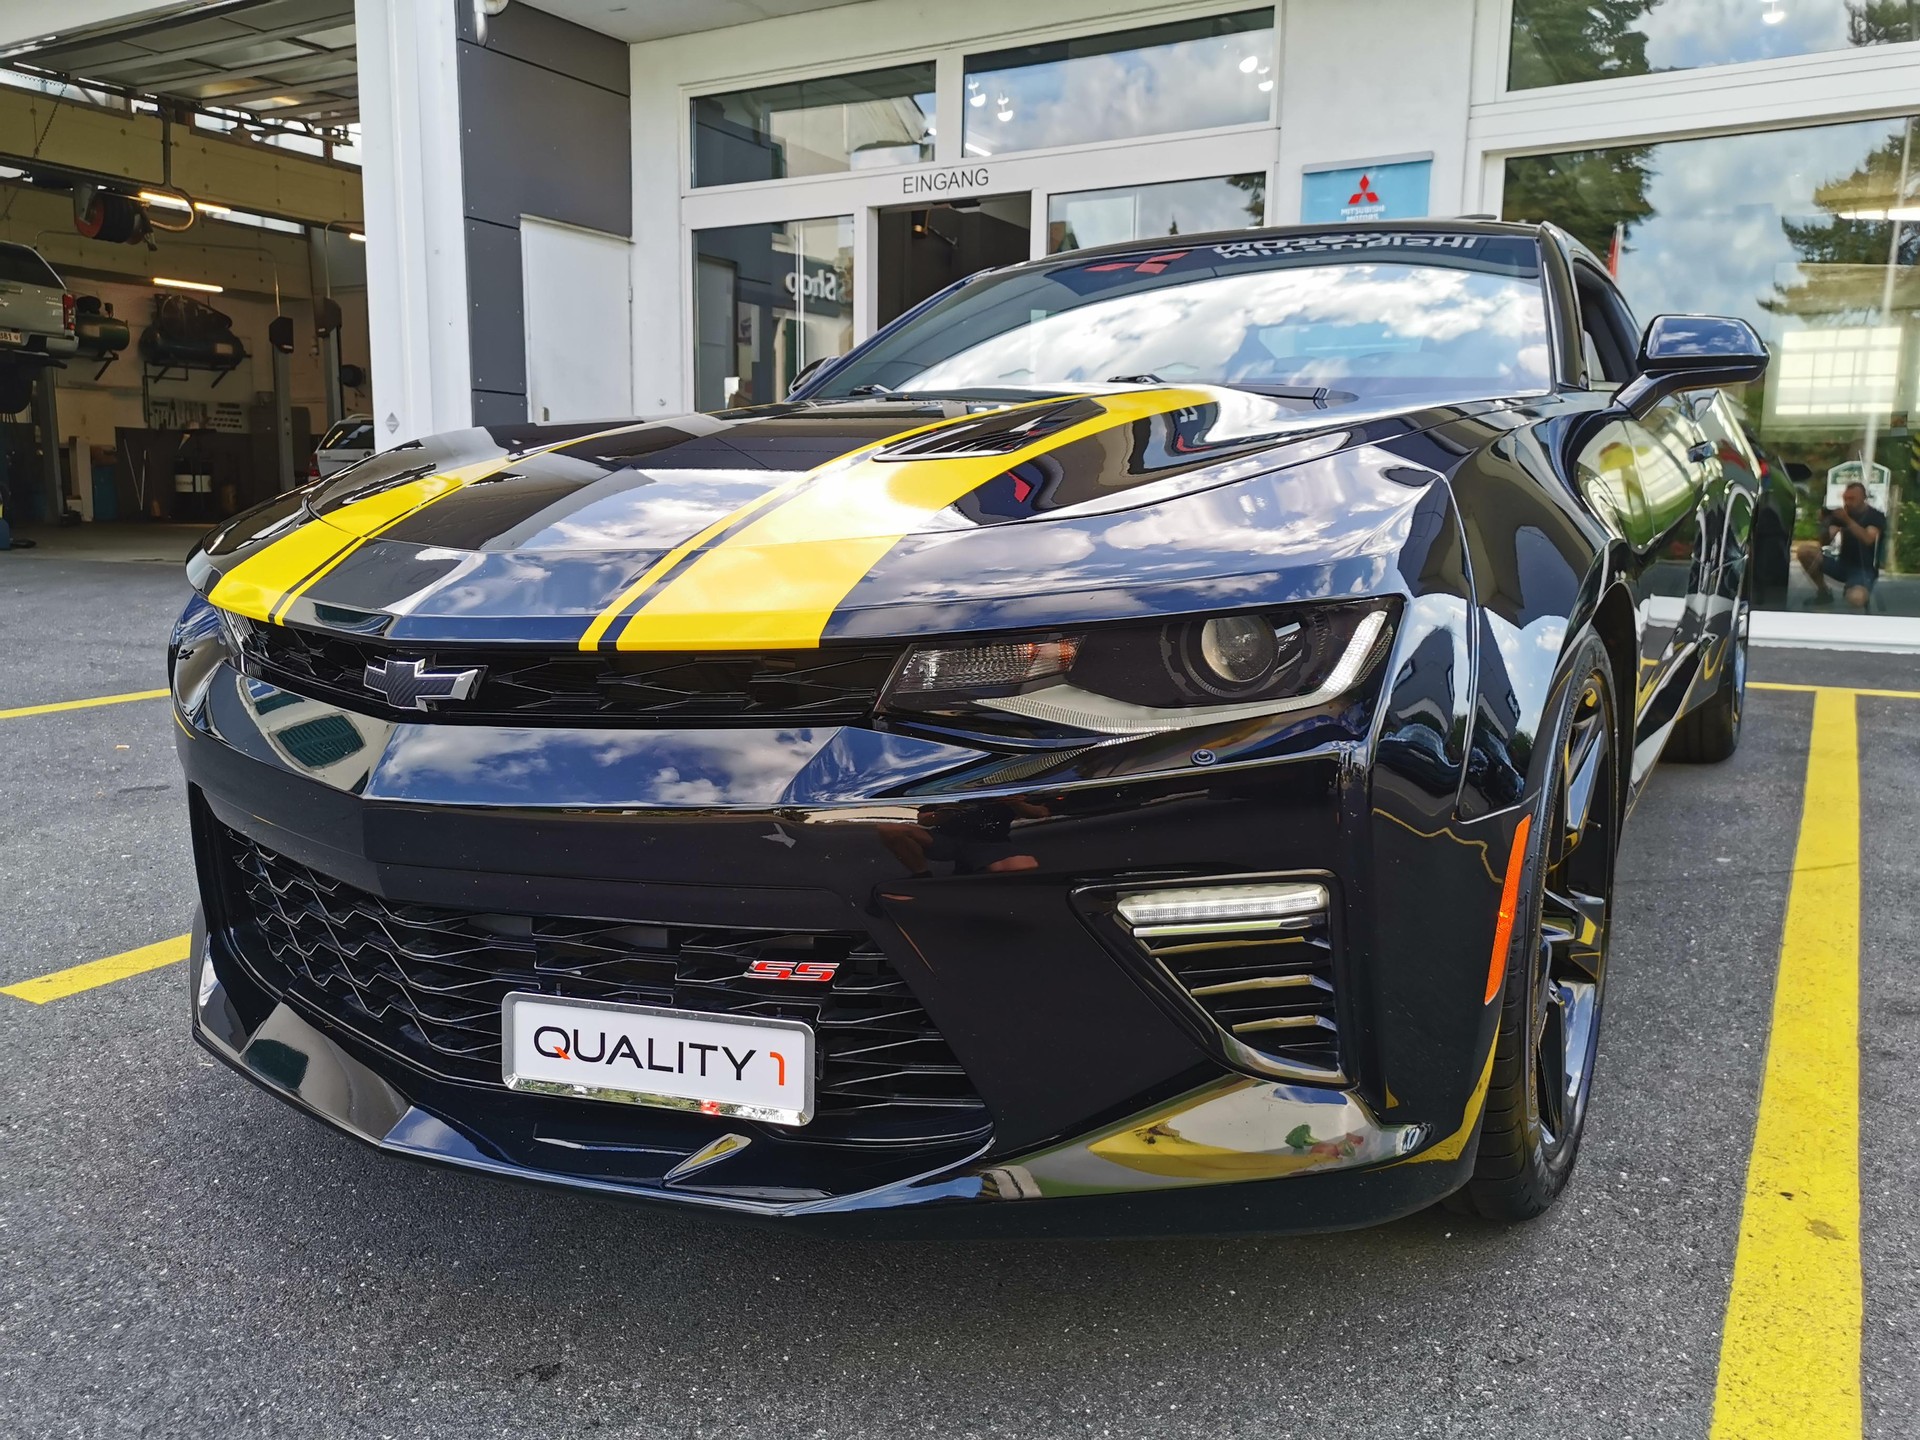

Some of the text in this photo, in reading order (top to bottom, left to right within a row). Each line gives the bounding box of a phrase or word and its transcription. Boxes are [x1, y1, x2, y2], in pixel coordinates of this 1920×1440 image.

[903, 168, 989, 194] EINGANG
[1341, 205, 1385, 216] MITSUBISHI
[744, 960, 840, 982] SS
[533, 1025, 785, 1086] QUALITY 1
